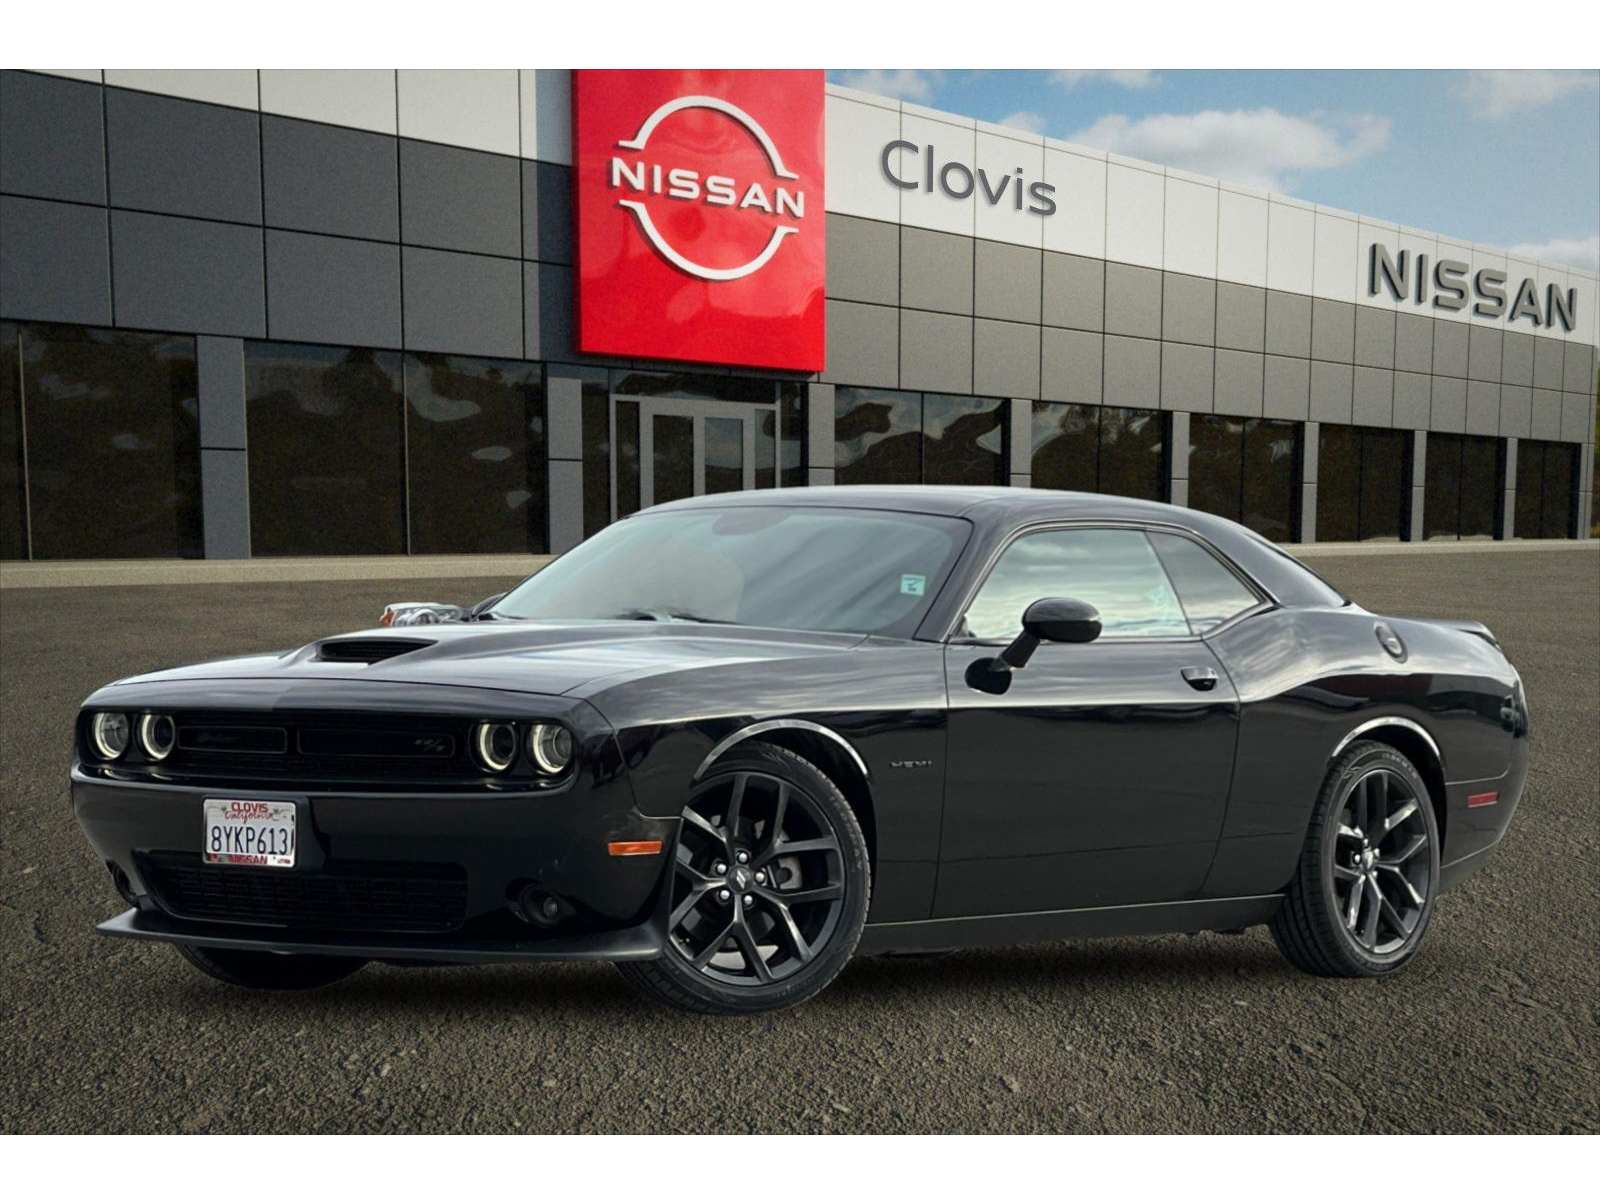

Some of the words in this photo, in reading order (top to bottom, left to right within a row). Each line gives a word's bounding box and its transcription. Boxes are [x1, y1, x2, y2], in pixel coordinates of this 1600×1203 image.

[611, 157, 804, 217] NISSAN
[882, 140, 1057, 216] Clovis
[1368, 243, 1578, 332] NISSAN
[231, 802, 268, 813] CLOVIS
[211, 826, 288, 855] 8YKP613
